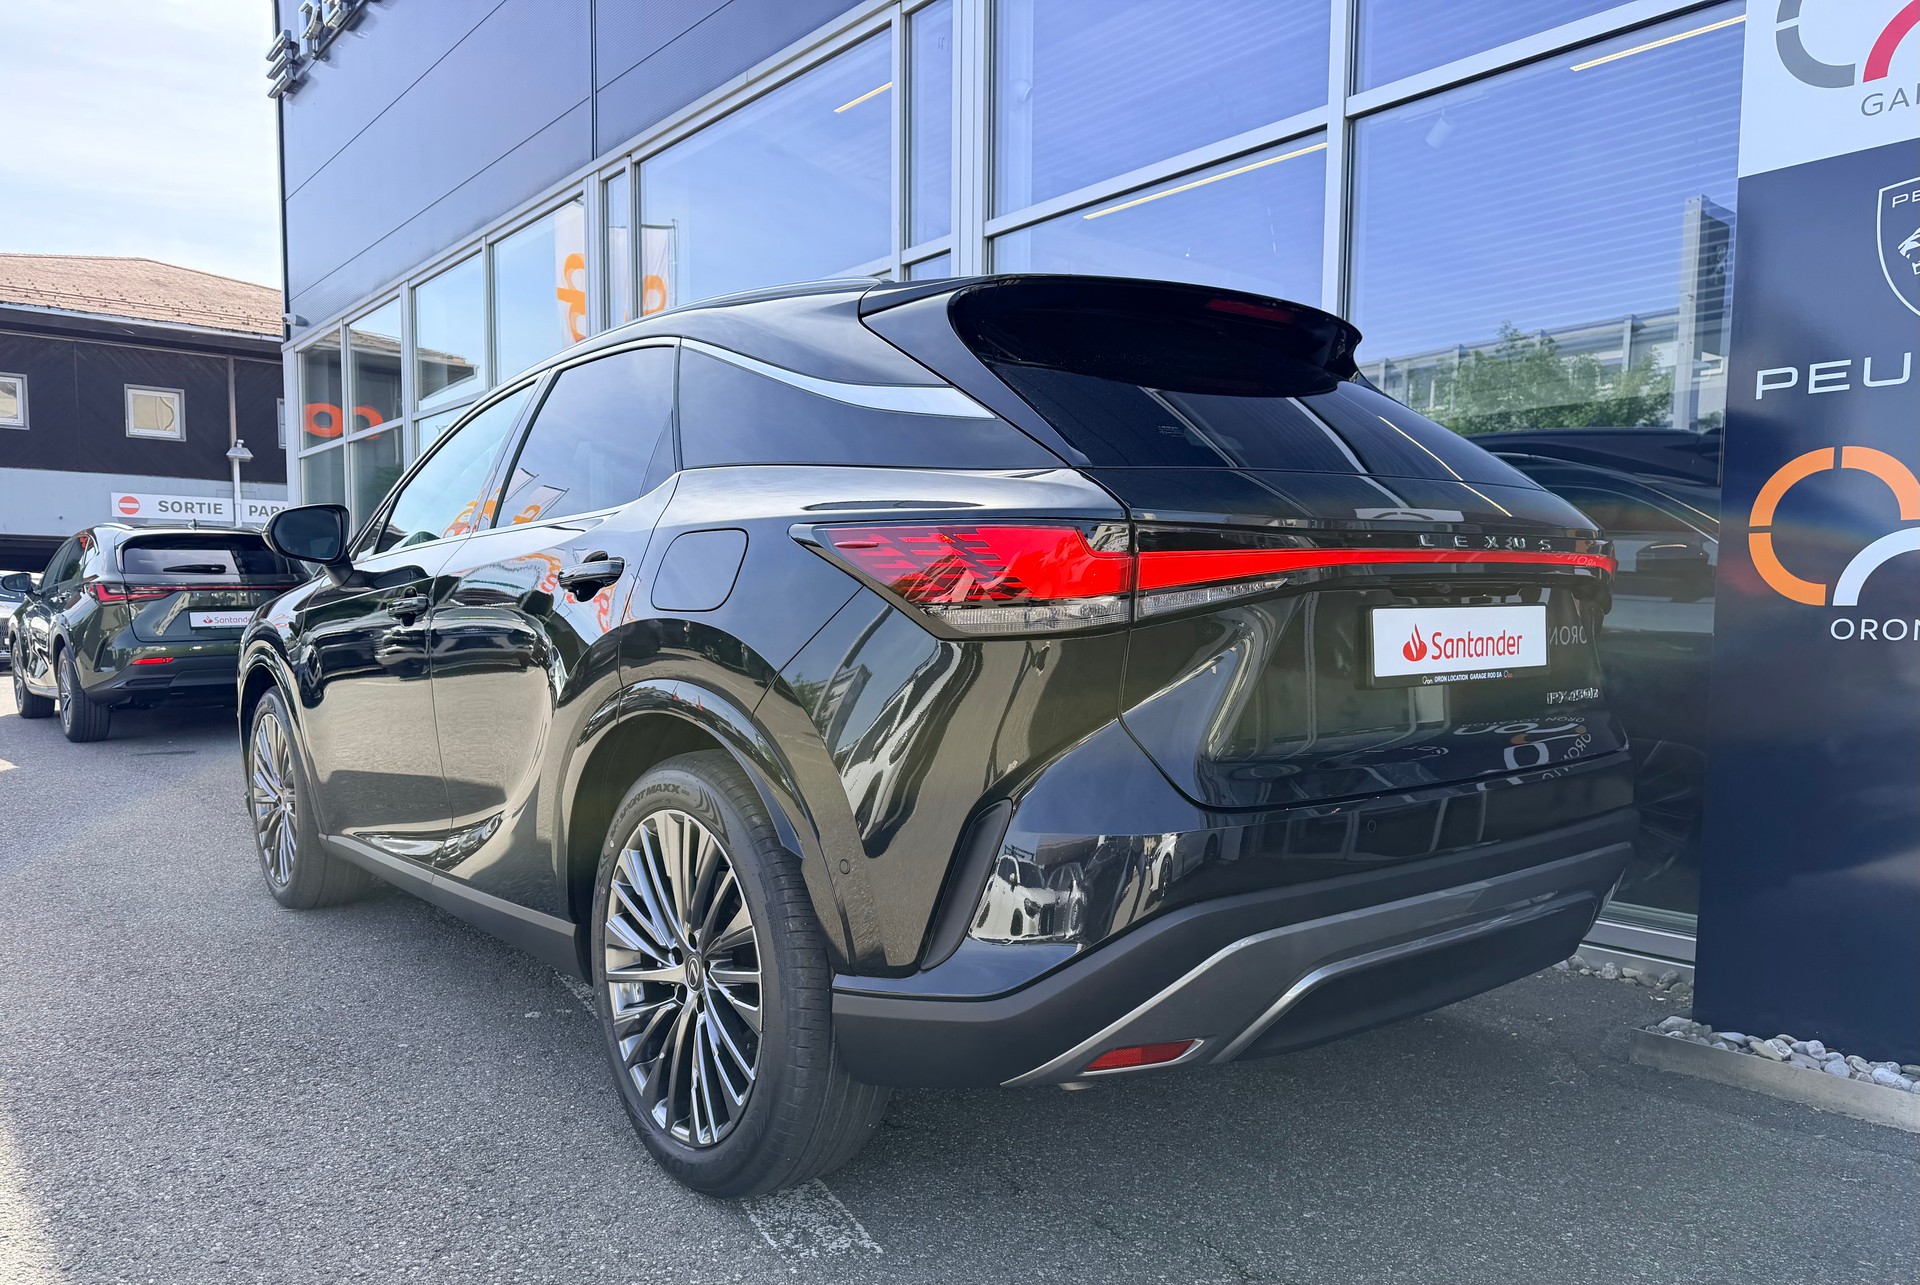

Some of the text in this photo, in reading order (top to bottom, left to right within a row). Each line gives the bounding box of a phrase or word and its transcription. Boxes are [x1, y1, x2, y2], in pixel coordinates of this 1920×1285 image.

[1861, 83, 1920, 117] GA
[1755, 351, 1912, 401] PEU
[158, 500, 223, 516] SORTIE
[248, 504, 287, 517] PAR
[1417, 534, 1552, 550] LEXUS
[1431, 630, 1523, 661] Santander
[1448, 674, 1468, 682] LOCATION
[646, 783, 681, 795] MAXX
